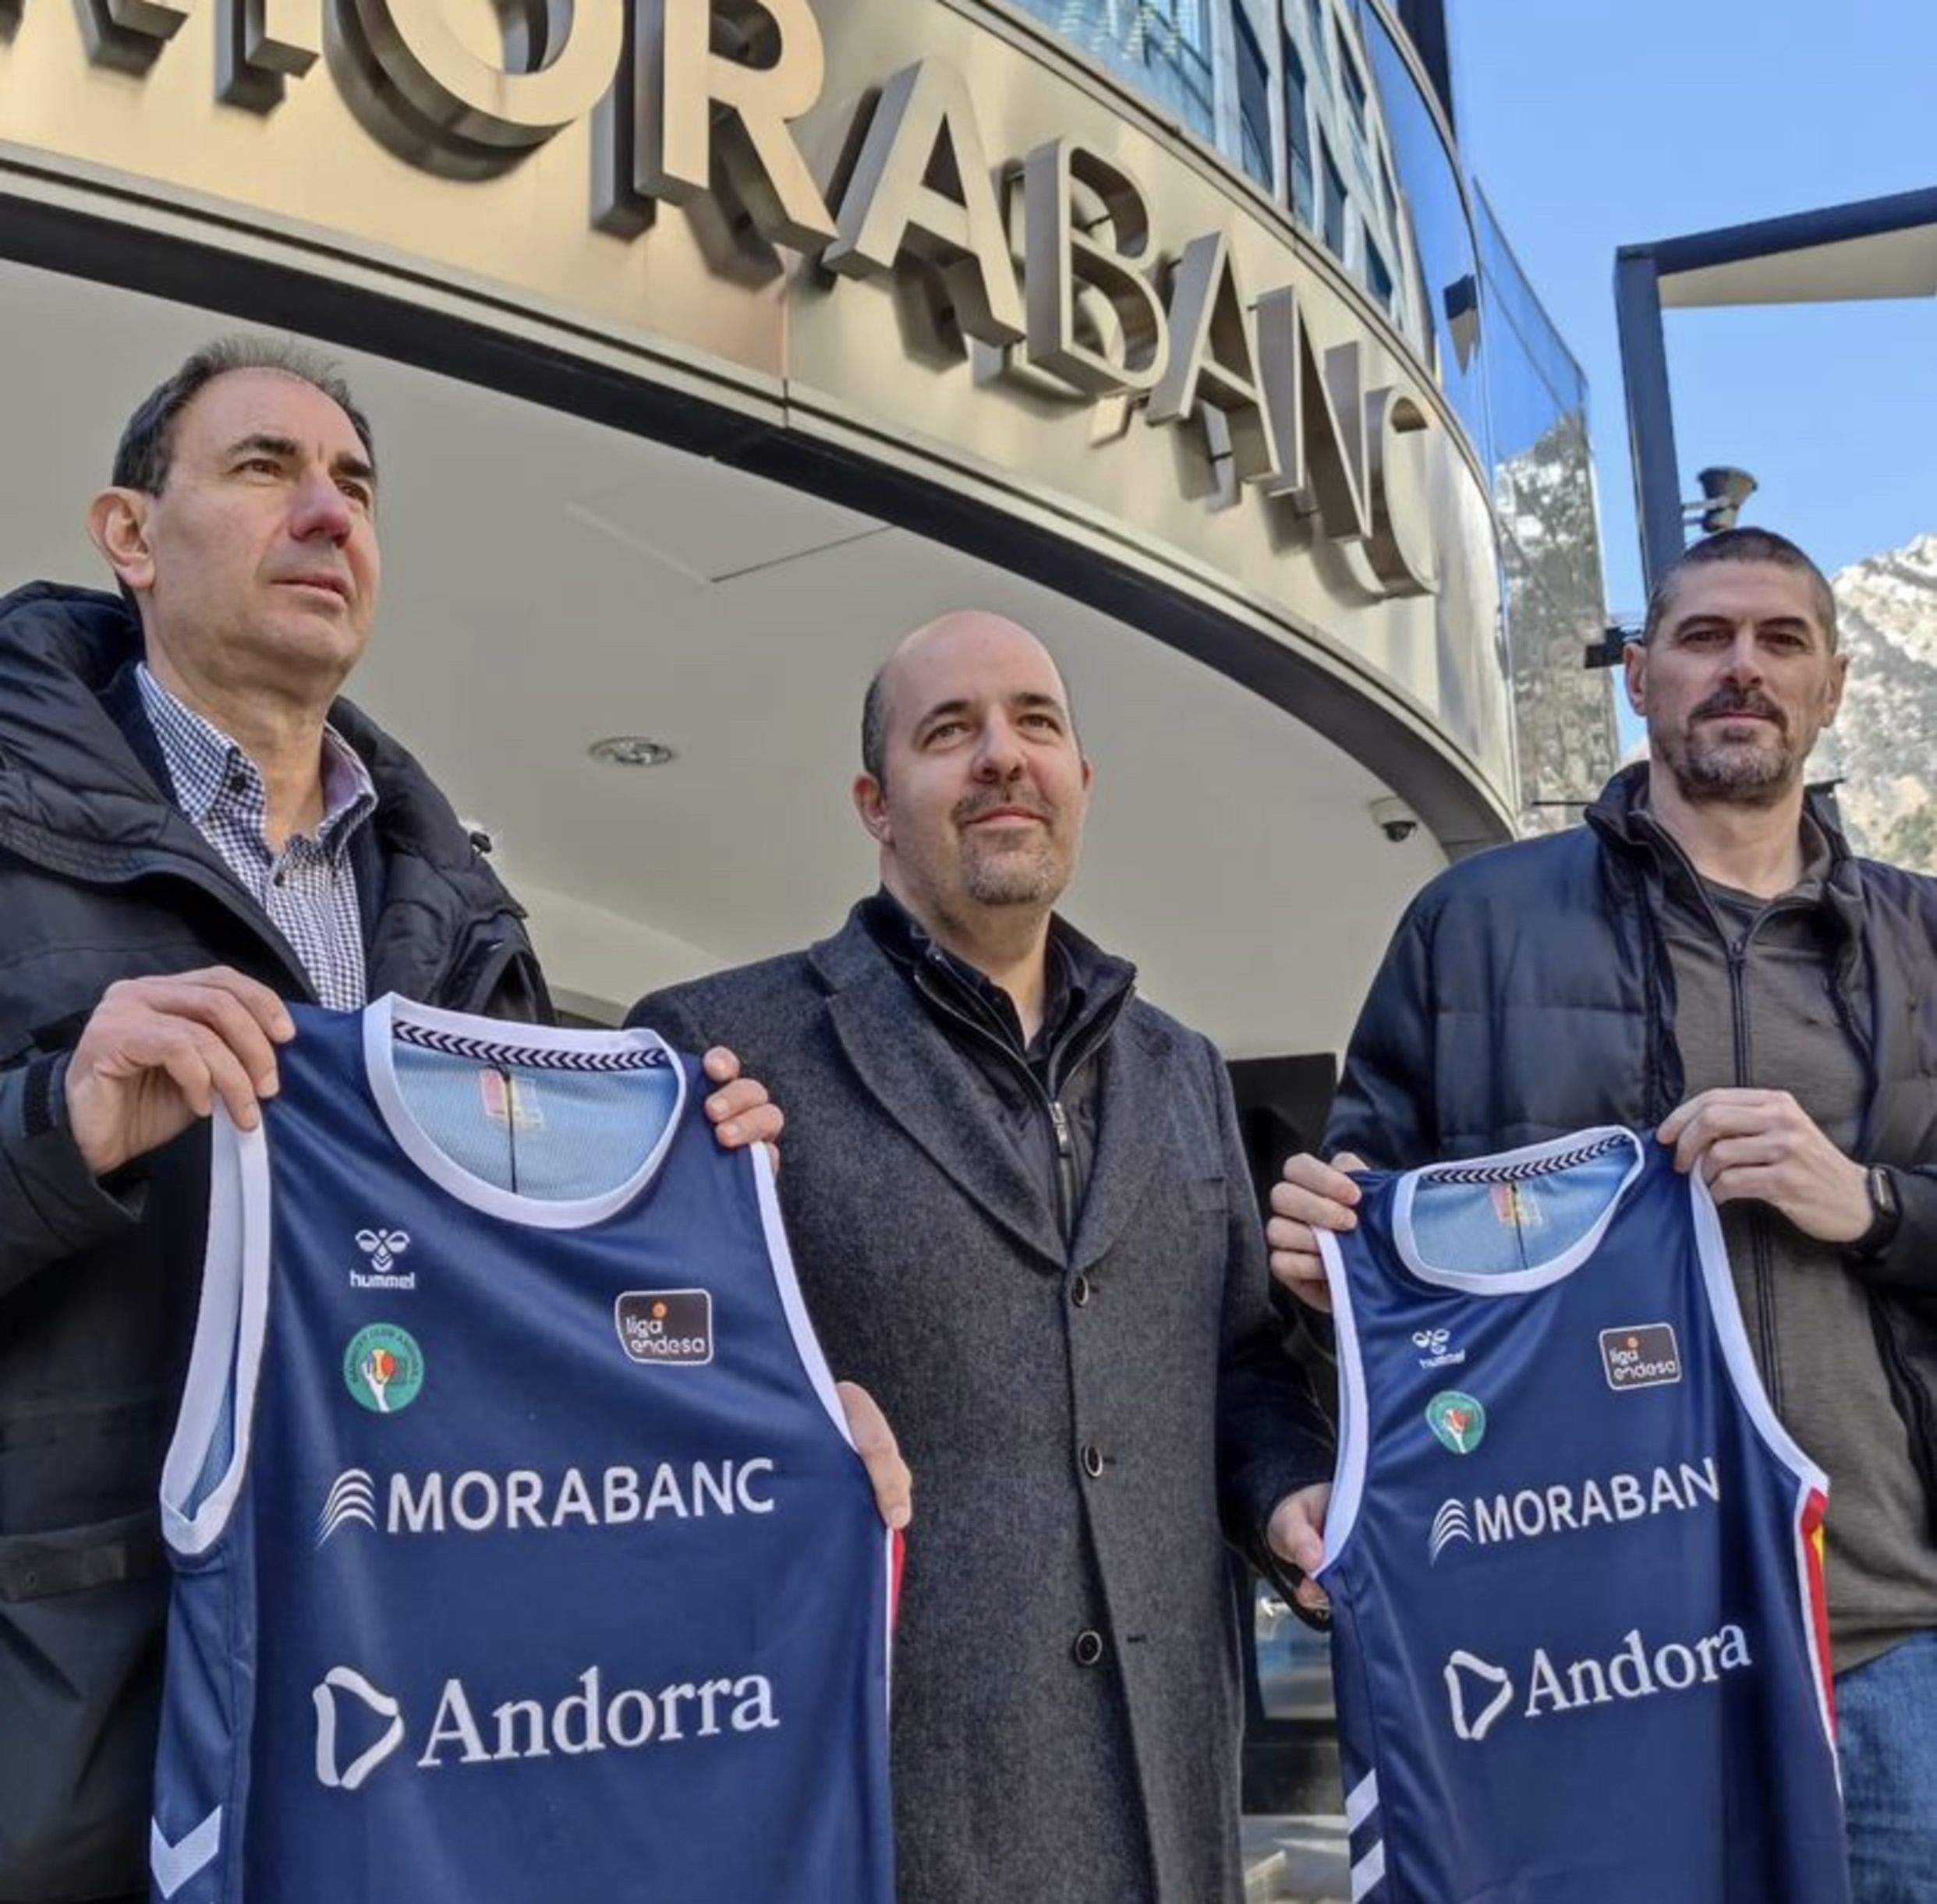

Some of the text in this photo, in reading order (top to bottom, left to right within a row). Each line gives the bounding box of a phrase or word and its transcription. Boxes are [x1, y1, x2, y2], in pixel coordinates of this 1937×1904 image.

[350, 1269, 415, 1290] hummel
[626, 1315, 663, 1338] liga
[631, 1336, 705, 1354] endesa
[1613, 1361, 1676, 1381] endesa
[388, 1458, 774, 1533] MORABANC
[1475, 1456, 1720, 1545] MORABAN
[417, 1665, 781, 1768] Andorra
